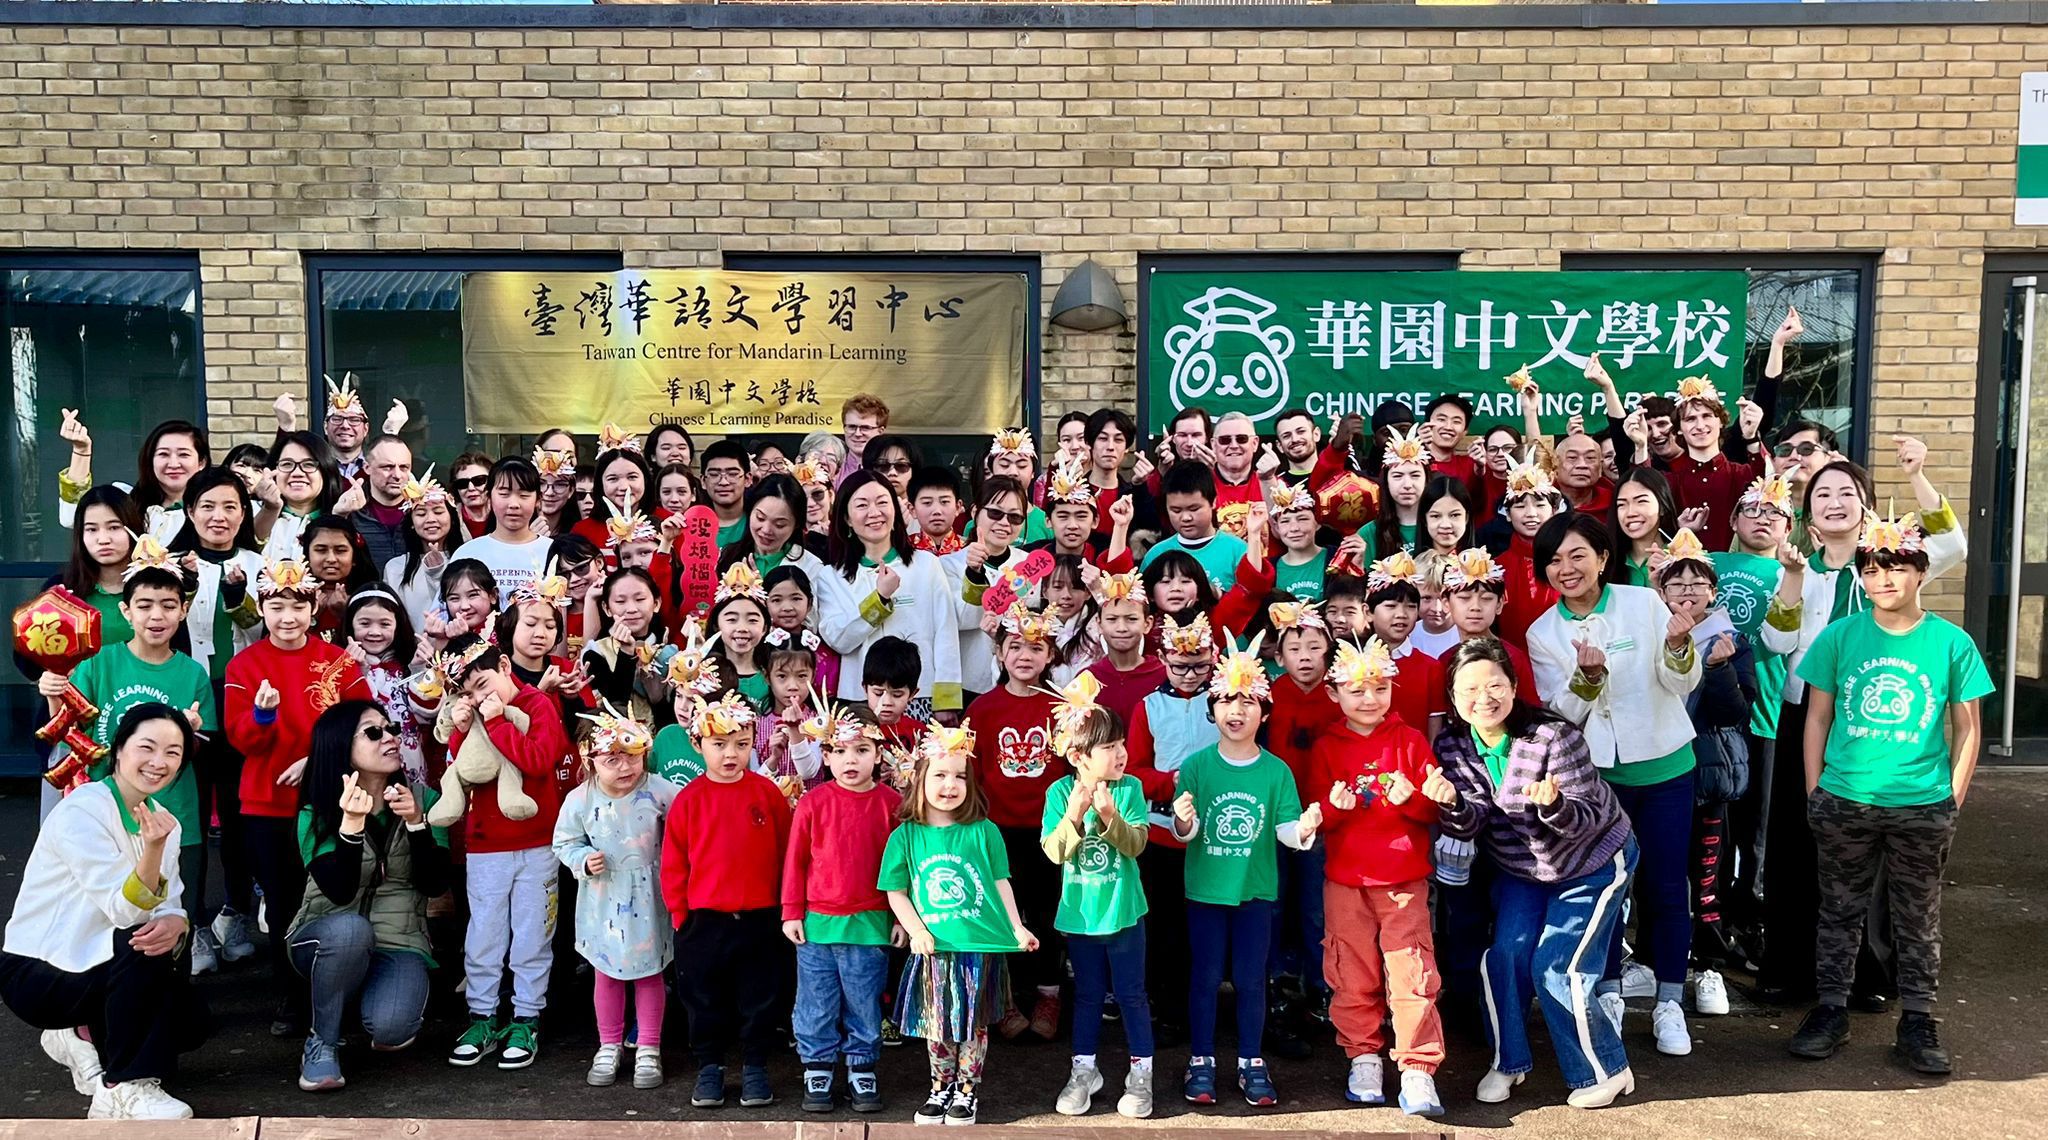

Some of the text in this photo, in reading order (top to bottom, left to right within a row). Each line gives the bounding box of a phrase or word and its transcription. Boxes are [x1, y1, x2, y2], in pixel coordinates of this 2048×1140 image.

[524, 279, 964, 335] 臺灣華語文學習中心
[1305, 299, 1731, 370] 華園中文學校
[582, 343, 907, 365] Taiwan Centre for Mandarin Learning
[649, 411, 833, 429] Chinese Learning Paradise
[1719, 571, 1765, 587] EARNING
[25, 611, 69, 656] 福
[113, 684, 170, 704] LEARNING
[1843, 674, 1858, 722] CHINESE
[1857, 657, 1919, 674] LEARNING
[663, 758, 704, 775] LEARNING
[1212, 791, 1258, 807] LEARNING
